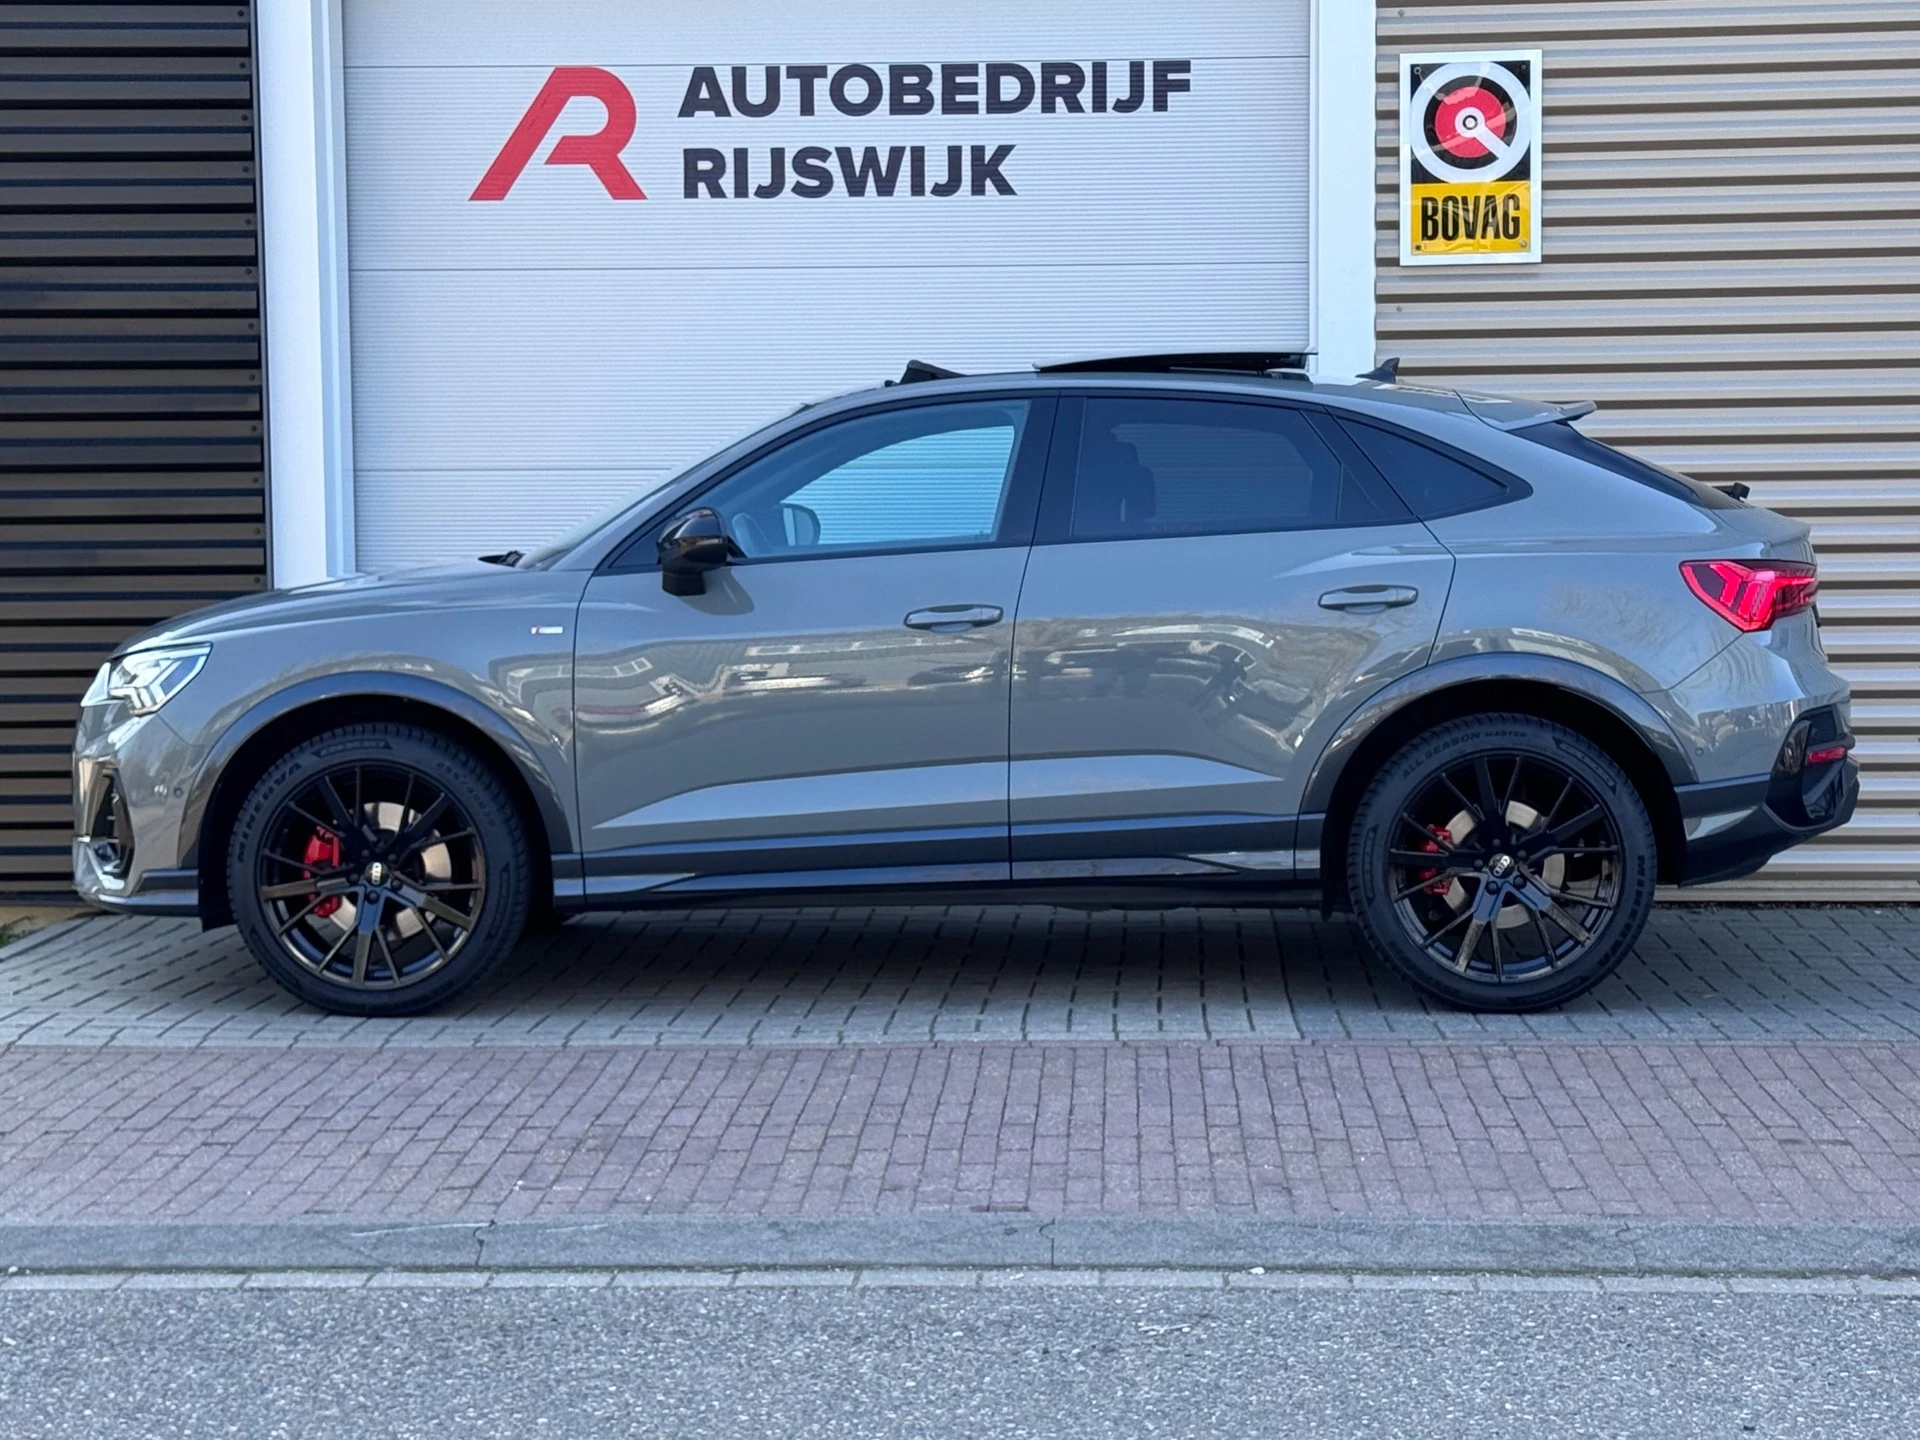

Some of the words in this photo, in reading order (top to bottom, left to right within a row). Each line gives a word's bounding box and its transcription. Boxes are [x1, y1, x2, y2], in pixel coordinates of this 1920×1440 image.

[678, 60, 1191, 118] AUTOBEDRIJF
[682, 144, 1017, 199] RIJSWIJK
[1421, 193, 1521, 241] BOVAG
[1424, 731, 1480, 760] SEASON
[237, 762, 302, 863] MINERVA
[1598, 855, 1646, 967] MINERVA
